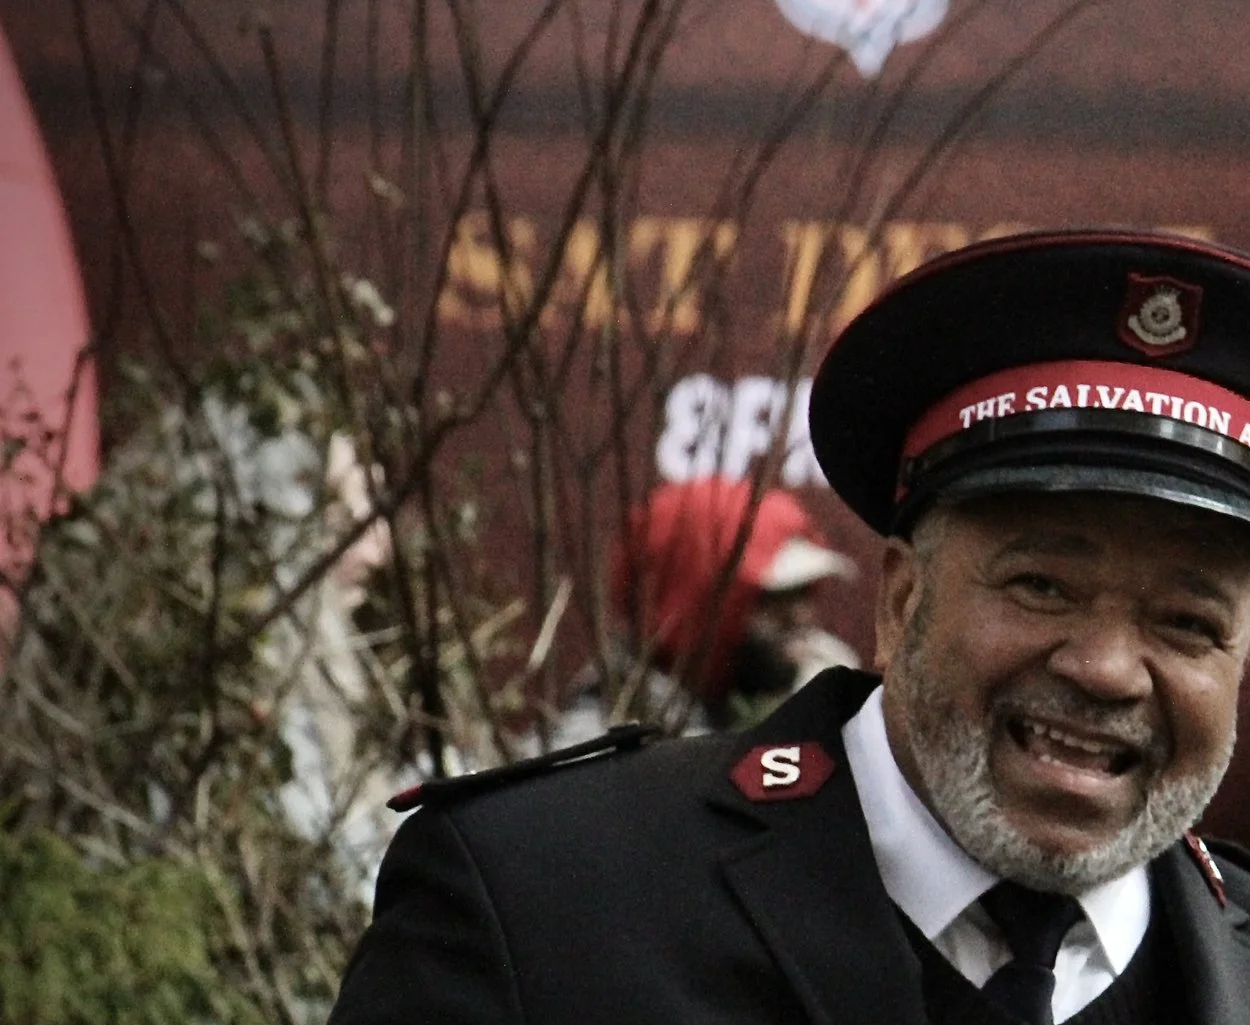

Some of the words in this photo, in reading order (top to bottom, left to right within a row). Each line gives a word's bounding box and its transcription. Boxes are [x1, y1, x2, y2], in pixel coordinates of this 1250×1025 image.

[959, 392, 1016, 429] THE
[1025, 384, 1232, 437] SALVATION
[760, 746, 801, 788] S
